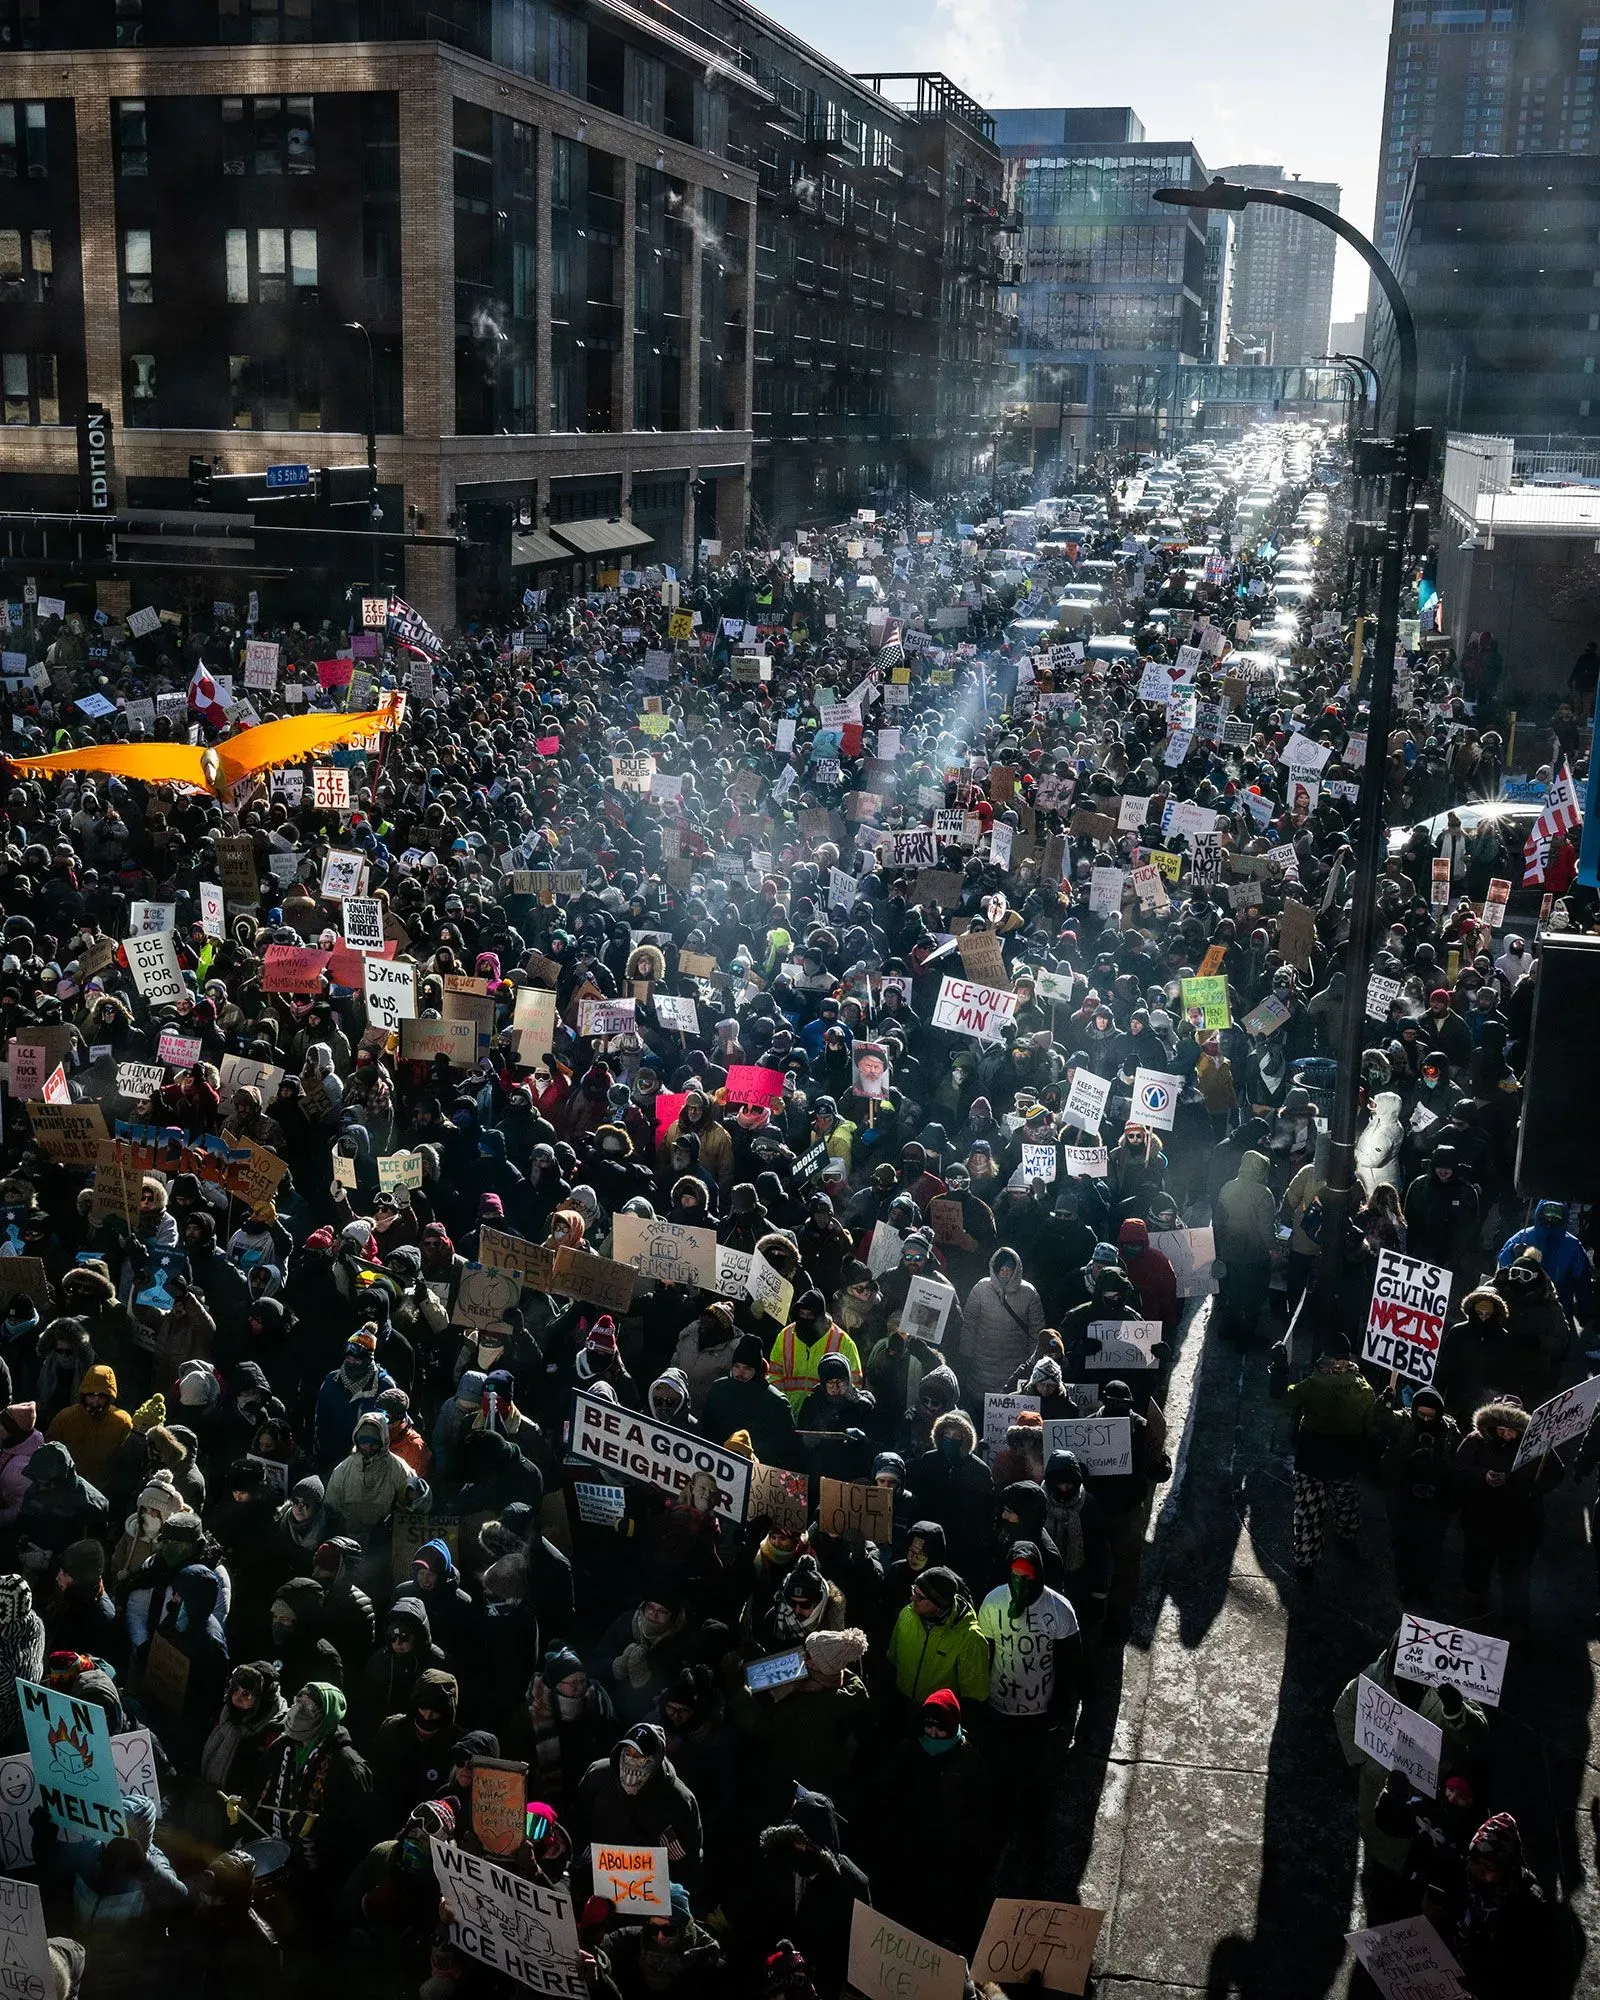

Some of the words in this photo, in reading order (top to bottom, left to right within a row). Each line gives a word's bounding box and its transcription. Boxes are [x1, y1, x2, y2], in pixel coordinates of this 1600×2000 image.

[87, 414, 108, 508] EDITION
[285, 469, 298, 480] 5th
[365, 605, 384, 615] ICE
[365, 615, 385, 624] OUT!
[89, 647, 109, 657] ICE
[1051, 645, 1071, 656] LIAM
[1052, 652, 1076, 663] RAMOS
[1150, 666, 1161, 675] WE
[1143, 675, 1161, 684] OUR
[237, 706, 253, 721] ICE
[350, 733, 378, 749] OUT!
[620, 759, 646, 770] DUE
[616, 768, 650, 777] PROCESS
[317, 777, 344, 792] ICE
[316, 793, 347, 806] OUT!
[1125, 802, 1144, 811] MINN
[938, 810, 948, 820] NO
[949, 810, 964, 820] ICE
[690, 822, 702, 834] ICE
[937, 821, 950, 830] IN
[950, 821, 963, 831] MN
[893, 834, 911, 848] ICE
[912, 832, 933, 845] OUT
[1194, 834, 1218, 847] WE
[226, 852, 243, 860] KKK
[893, 848, 905, 864] OF
[905, 844, 935, 863] MN
[1194, 847, 1222, 859] ARE
[1278, 849, 1294, 859] OUT
[1167, 857, 1178, 865] OUT
[1193, 859, 1222, 872] NOT
[513, 871, 528, 891] WE
[529, 871, 543, 891] ALL
[547, 871, 582, 891] BELONG
[833, 873, 855, 892] END
[1134, 866, 1158, 884] FUCK
[1233, 885, 1255, 895] ICE
[344, 898, 379, 906] ARREST
[1236, 896, 1256, 904] OUT
[144, 908, 165, 919] ICE
[346, 904, 379, 915] JONATHAN
[143, 921, 164, 931] OUT
[349, 913, 364, 923] ROSS
[364, 914, 378, 924] FOR
[347, 923, 380, 937] MURDER
[133, 939, 162, 954] ICE
[346, 937, 383, 948] NOW!
[270, 945, 290, 957] MN
[138, 954, 164, 968] OUT
[277, 958, 308, 968] WANTS
[144, 968, 172, 983] FOR
[368, 963, 413, 985] 5-YEAR-
[1372, 975, 1382, 983] ICE
[1383, 980, 1400, 990] OUT
[144, 983, 181, 999] GOOD
[944, 980, 1017, 1014] ICE-OUT
[369, 993, 399, 1013] OLDS,
[1265, 1000, 1284, 1016] ICE
[593, 1016, 635, 1033] SILENT
[955, 1006, 990, 1032] MN
[450, 1025, 469, 1035] COLD
[160, 1035, 173, 1046] NO
[174, 1038, 188, 1048] ONE
[190, 1040, 200, 1049] IS
[410, 1040, 455, 1054] TYRANNY
[160, 1046, 193, 1058] ILLEGAL
[17, 1066, 37, 1076] FUCK
[119, 1063, 163, 1082] CHINGA
[227, 1063, 268, 1088] ICE
[731, 1070, 754, 1081] ICE
[119, 1079, 154, 1093] MIGRA
[1076, 1080, 1092, 1091] KEEP
[1093, 1086, 1105, 1098] THE
[37, 1106, 64, 1116] KEEP
[1069, 1101, 1099, 1121] RACISTS
[1071, 1095, 1091, 1108] DEPORT
[1091, 1103, 1102, 1112] THE
[33, 1117, 94, 1130] MINNESOTA
[62, 1129, 88, 1139] NICE
[40, 1140, 78, 1157] ABOLISH
[1022, 1145, 1055, 1156] STAND
[251, 1152, 272, 1173] NO
[380, 1161, 400, 1174] ICE
[402, 1158, 421, 1171] OUT
[1024, 1156, 1055, 1167] WITH
[99, 1166, 140, 1182] VIOLENCE
[1024, 1166, 1053, 1177] MPLS
[639, 1231, 649, 1242] I
[647, 1225, 685, 1239] PREFER
[686, 1236, 700, 1249] MY
[482, 1230, 550, 1264] ABOLISH
[655, 1243, 673, 1257] ICE
[573, 1255, 629, 1282] LOVE
[630, 1254, 699, 1285] CRUSHED
[1381, 1252, 1441, 1290] IT'S
[720, 1269, 749, 1284] OUT
[760, 1264, 782, 1294] ICE
[553, 1270, 595, 1297] MELTS
[599, 1283, 632, 1306] ICE
[756, 1276, 782, 1302] OUT
[1376, 1276, 1447, 1317] GIVING
[467, 1304, 498, 1319] REBEL
[1090, 1323, 1130, 1341] Tired
[1136, 1322, 1154, 1341] of
[1370, 1297, 1443, 1351] NAZIS
[1365, 1330, 1436, 1382] VIBES
[1022, 1402, 1036, 1411] are
[1532, 1390, 1575, 1427] STOP
[583, 1404, 622, 1437] BE
[625, 1423, 645, 1447] A
[651, 1433, 736, 1483] GOOD
[581, 1431, 733, 1514] NEIGHBR
[768, 1489, 786, 1506] NO
[839, 1483, 881, 1514] ICE
[832, 1508, 884, 1540] OUT
[1406, 1623, 1463, 1652] ICE
[1404, 1653, 1423, 1664] one
[1409, 1646, 1423, 1656] No
[1442, 1675, 1453, 1683] on
[1366, 1686, 1403, 1721] STOP
[1359, 1702, 1395, 1737] TAKING
[1397, 1728, 1416, 1749] THE
[1363, 1726, 1390, 1759] KIDS
[39, 1783, 125, 1837] MELTS
[473, 1801, 523, 1820] DEMOCRACY
[598, 1852, 652, 1871] ABOLISH
[436, 1844, 484, 1883] WE
[490, 1868, 568, 1920] MELT
[1013, 1907, 1068, 1940] ICE
[870, 1926, 941, 1977] ABOLISH
[453, 1924, 498, 1964] ICE
[506, 1949, 589, 2000] HERE
[987, 1939, 1067, 1980] OUT
[880, 1962, 912, 1996] ICE
